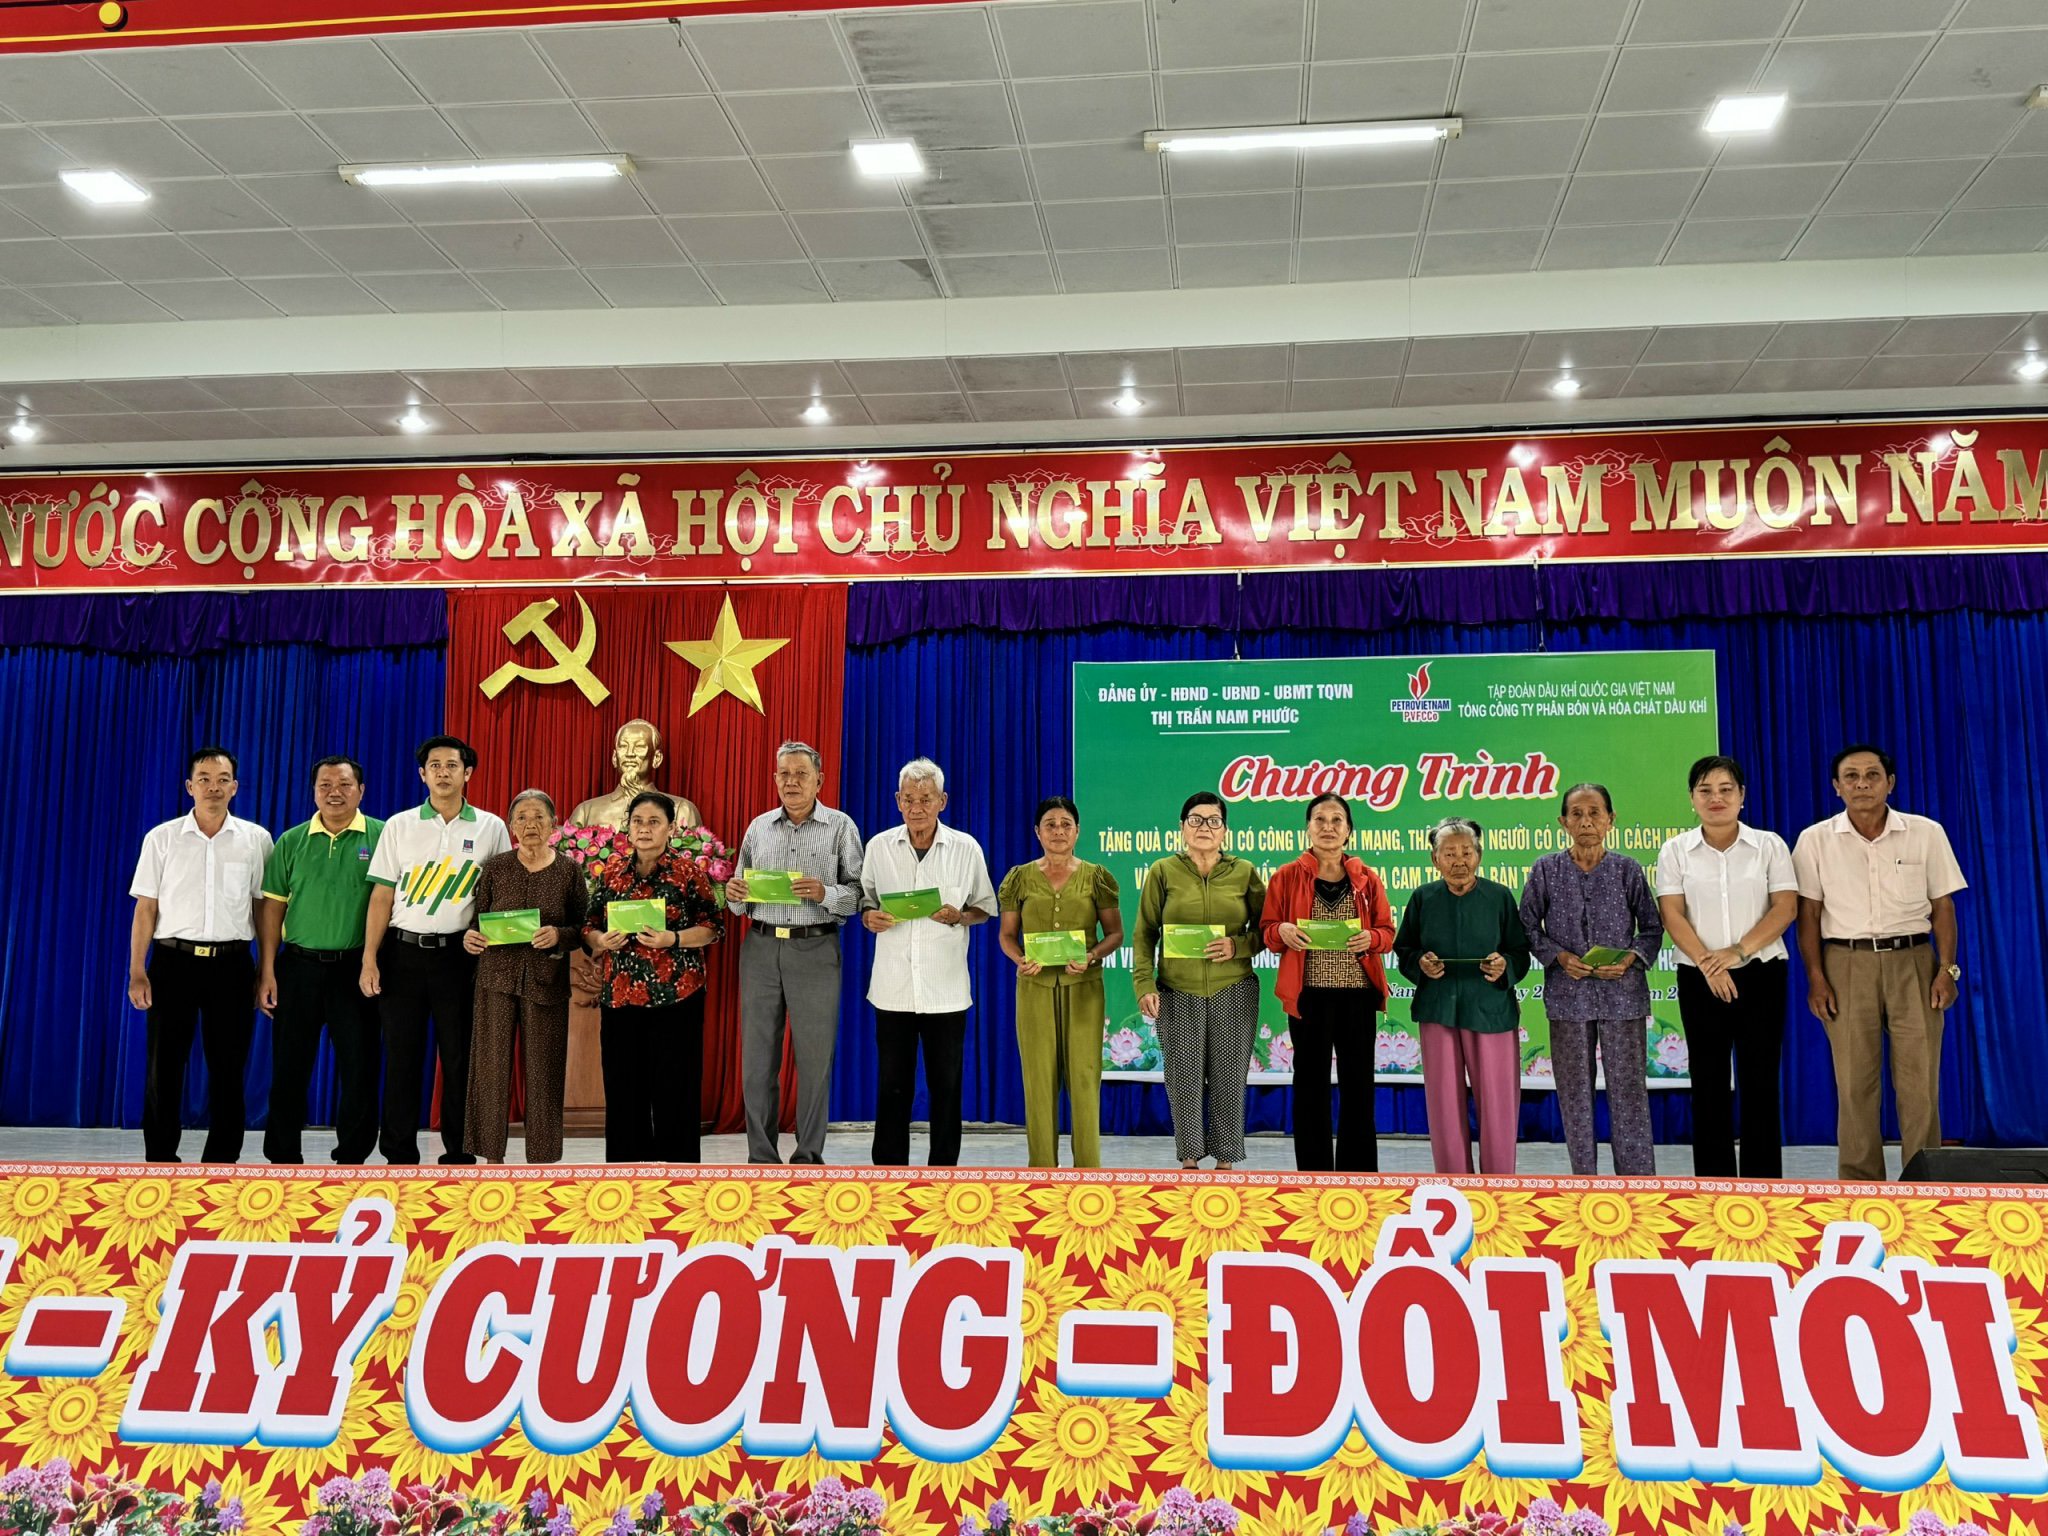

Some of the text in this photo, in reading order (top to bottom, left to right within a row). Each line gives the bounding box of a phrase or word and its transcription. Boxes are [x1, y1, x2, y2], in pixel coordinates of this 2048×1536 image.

[0, 428, 2048, 580] NƯỚC CỘNG HÒA XÃ HỘI CHỦ NGHĨA VIỆT NAM MUÔN NĂM
[1098, 682, 1136, 702] ĐẢNG
[1140, 682, 1158, 702] ỦY
[1171, 687, 1209, 701] HĐND
[1222, 685, 1260, 701] UBND
[1274, 684, 1312, 700] UBMT
[1316, 684, 1353, 700] TQVN
[1487, 683, 1507, 701] TẬP
[1508, 682, 1536, 699] ĐOÀN
[1560, 680, 1577, 697] KHÍ
[1610, 682, 1628, 696] GIA
[1629, 681, 1651, 699] VIỆT
[1653, 681, 1675, 696] NAM
[1151, 705, 1300, 728] THỊ TRẤN NAM PHƯỚC
[1391, 700, 1450, 711] PETROVIETNAM
[1489, 701, 1519, 717] CÔNG
[1521, 703, 1534, 717] TY
[1536, 700, 1565, 716] PHÂN
[1567, 700, 1590, 716] BÓN
[1592, 698, 1606, 715] VÀ
[1608, 699, 1631, 715] HÓA
[1689, 696, 1707, 713] KHÍ
[1220, 749, 1558, 810] Chương Trình
[1099, 826, 1132, 856] TẶNG
[1136, 827, 1162, 854] QUÀ
[1237, 826, 1254, 851] CÓ
[1258, 825, 1294, 851] CÔNG
[1361, 829, 1405, 856] MẠNG,
[1408, 825, 1433, 850] THÂ
[1489, 823, 1530, 850] NGƯỜI
[1534, 824, 1552, 850] CÓ
[1624, 823, 1661, 850] CÁCH
[1391, 866, 1422, 889] CAM
[138, 1209, 394, 1416] KỶ
[422, 1248, 1011, 1431] CƯƠNG
[1072, 1324, 1159, 1366] -
[1221, 1198, 1565, 1445] ĐỔI
[1610, 1235, 2030, 1460] MỚI
